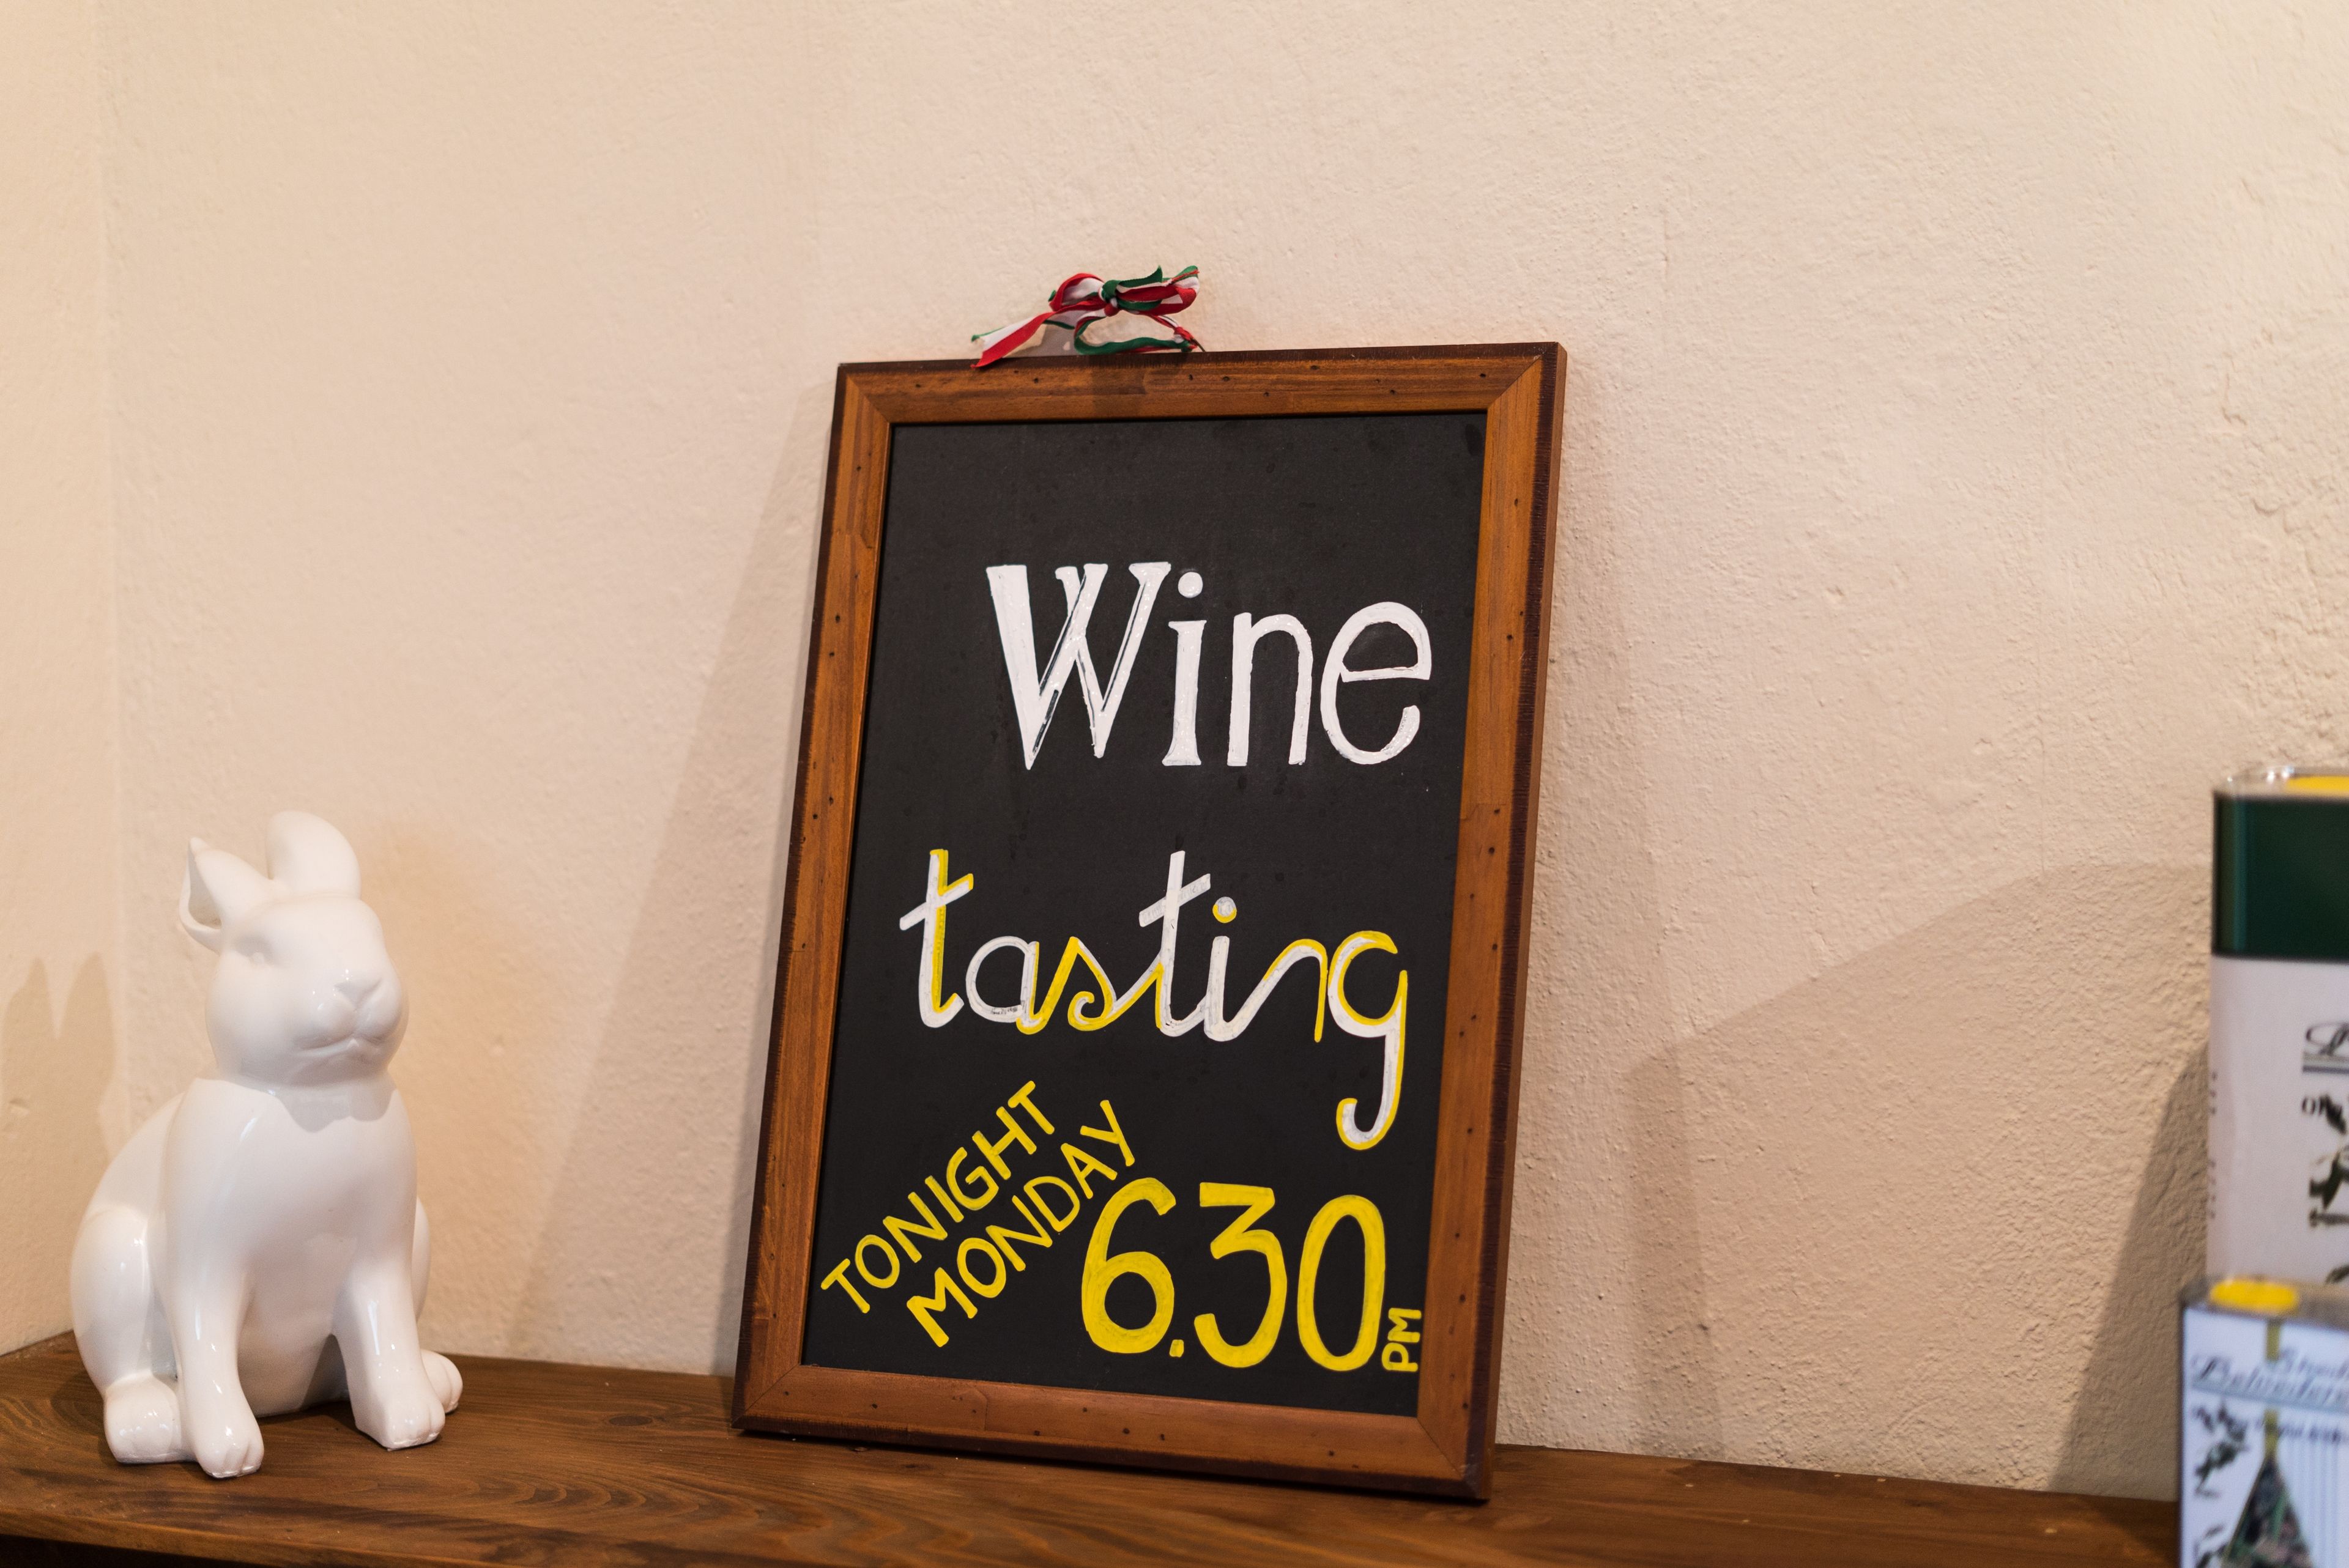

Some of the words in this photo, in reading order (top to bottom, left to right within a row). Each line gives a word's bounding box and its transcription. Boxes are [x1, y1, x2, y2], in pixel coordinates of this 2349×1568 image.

[986, 562, 1432, 769] Wine
[899, 849, 1408, 1150] tasting
[821, 1081, 1055, 1312] TONIGHT
[907, 1100, 1135, 1347] MONDAY
[1082, 1178, 1386, 1371] 6.30
[1382, 1308, 1422, 1372] PM
